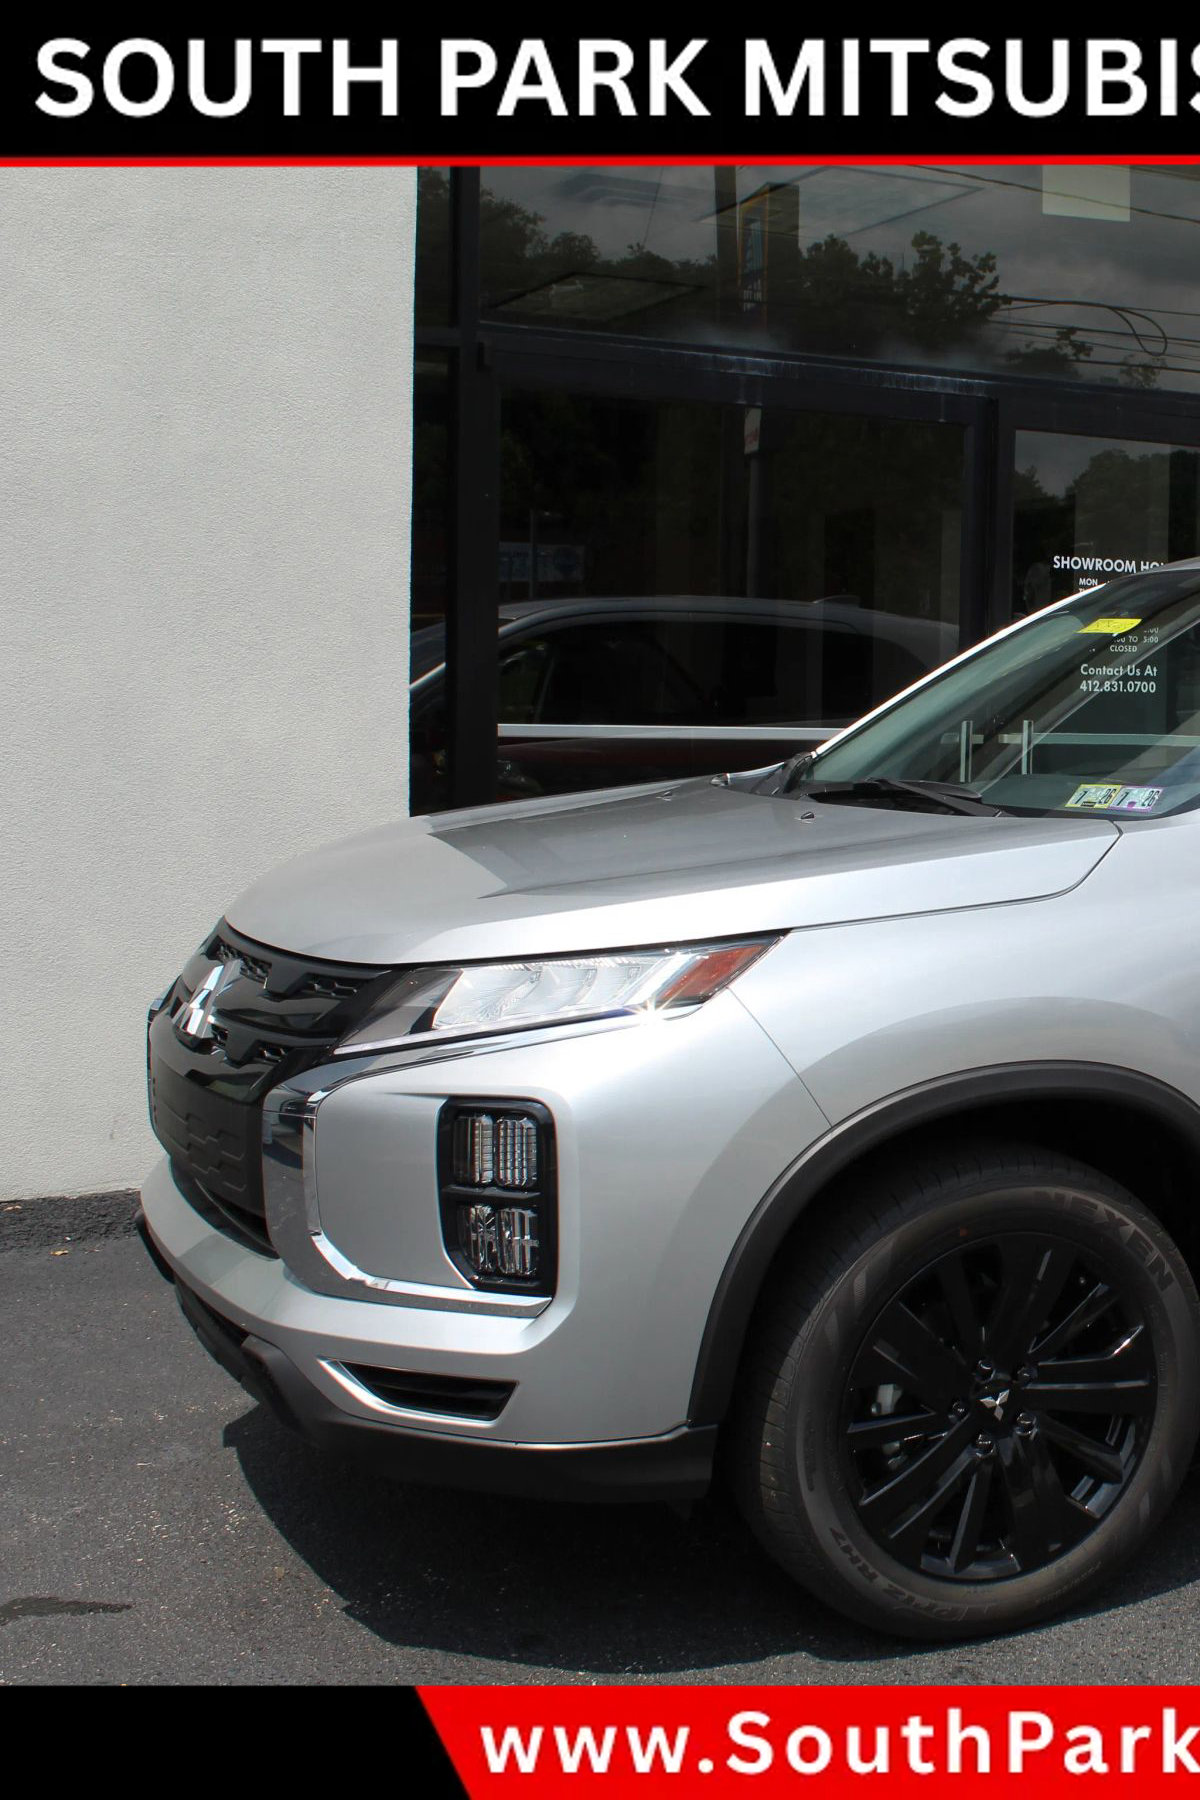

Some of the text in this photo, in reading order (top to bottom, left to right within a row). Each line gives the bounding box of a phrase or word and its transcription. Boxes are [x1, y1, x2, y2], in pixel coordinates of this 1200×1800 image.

[1053, 555, 1137, 574] SHOWROOM
[1079, 577, 1098, 586] MON
[1109, 645, 1138, 653] CLOSED
[1080, 664, 1158, 677] Contact Us At
[1080, 680, 1156, 693] 412.831.0700
[1033, 1189, 1175, 1292] NEXEN
